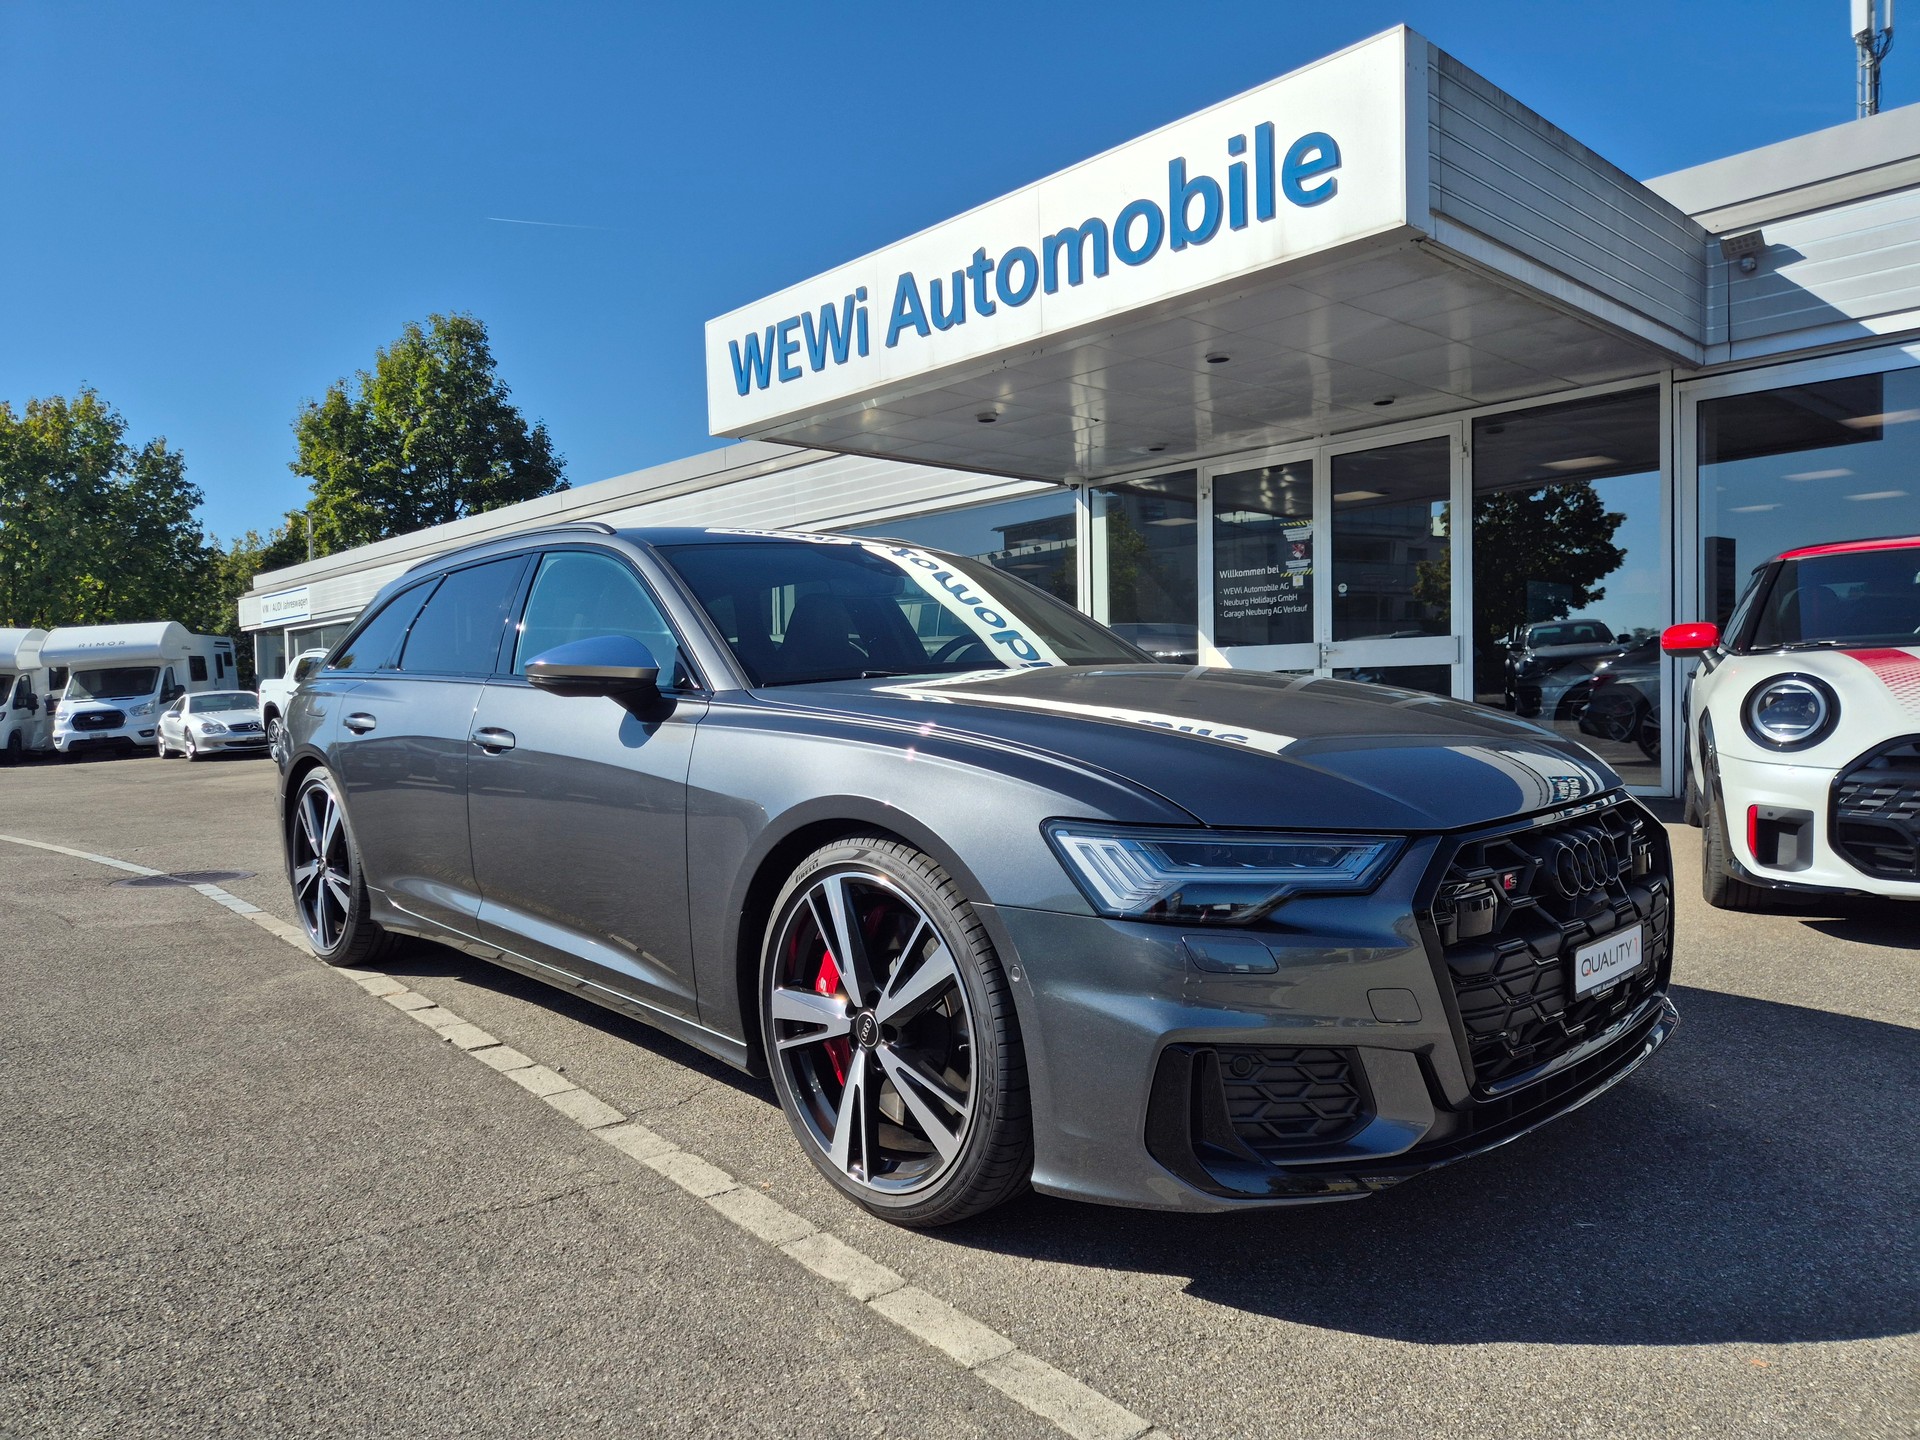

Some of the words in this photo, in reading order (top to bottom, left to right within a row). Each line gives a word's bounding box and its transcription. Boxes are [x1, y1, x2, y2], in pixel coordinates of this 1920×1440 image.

[729, 286, 869, 397] WEWi
[886, 121, 1342, 347] Automobile
[1219, 568, 1266, 579] Willkommen
[1267, 565, 1279, 574] bei
[1224, 587, 1243, 595] WEWi
[1244, 583, 1279, 594] Automobile
[1280, 582, 1289, 590] AG
[1224, 598, 1249, 607] Neuburg
[1250, 596, 1277, 605] Holidays
[1278, 594, 1298, 602] GmbH
[1224, 609, 1245, 618] Garage
[1246, 607, 1272, 616] Neuburg
[1283, 604, 1308, 613] Verkauf
[79, 640, 126, 648] RIMOR
[1581, 940, 1632, 977] QUALITY
[1634, 937, 1639, 953] 1
